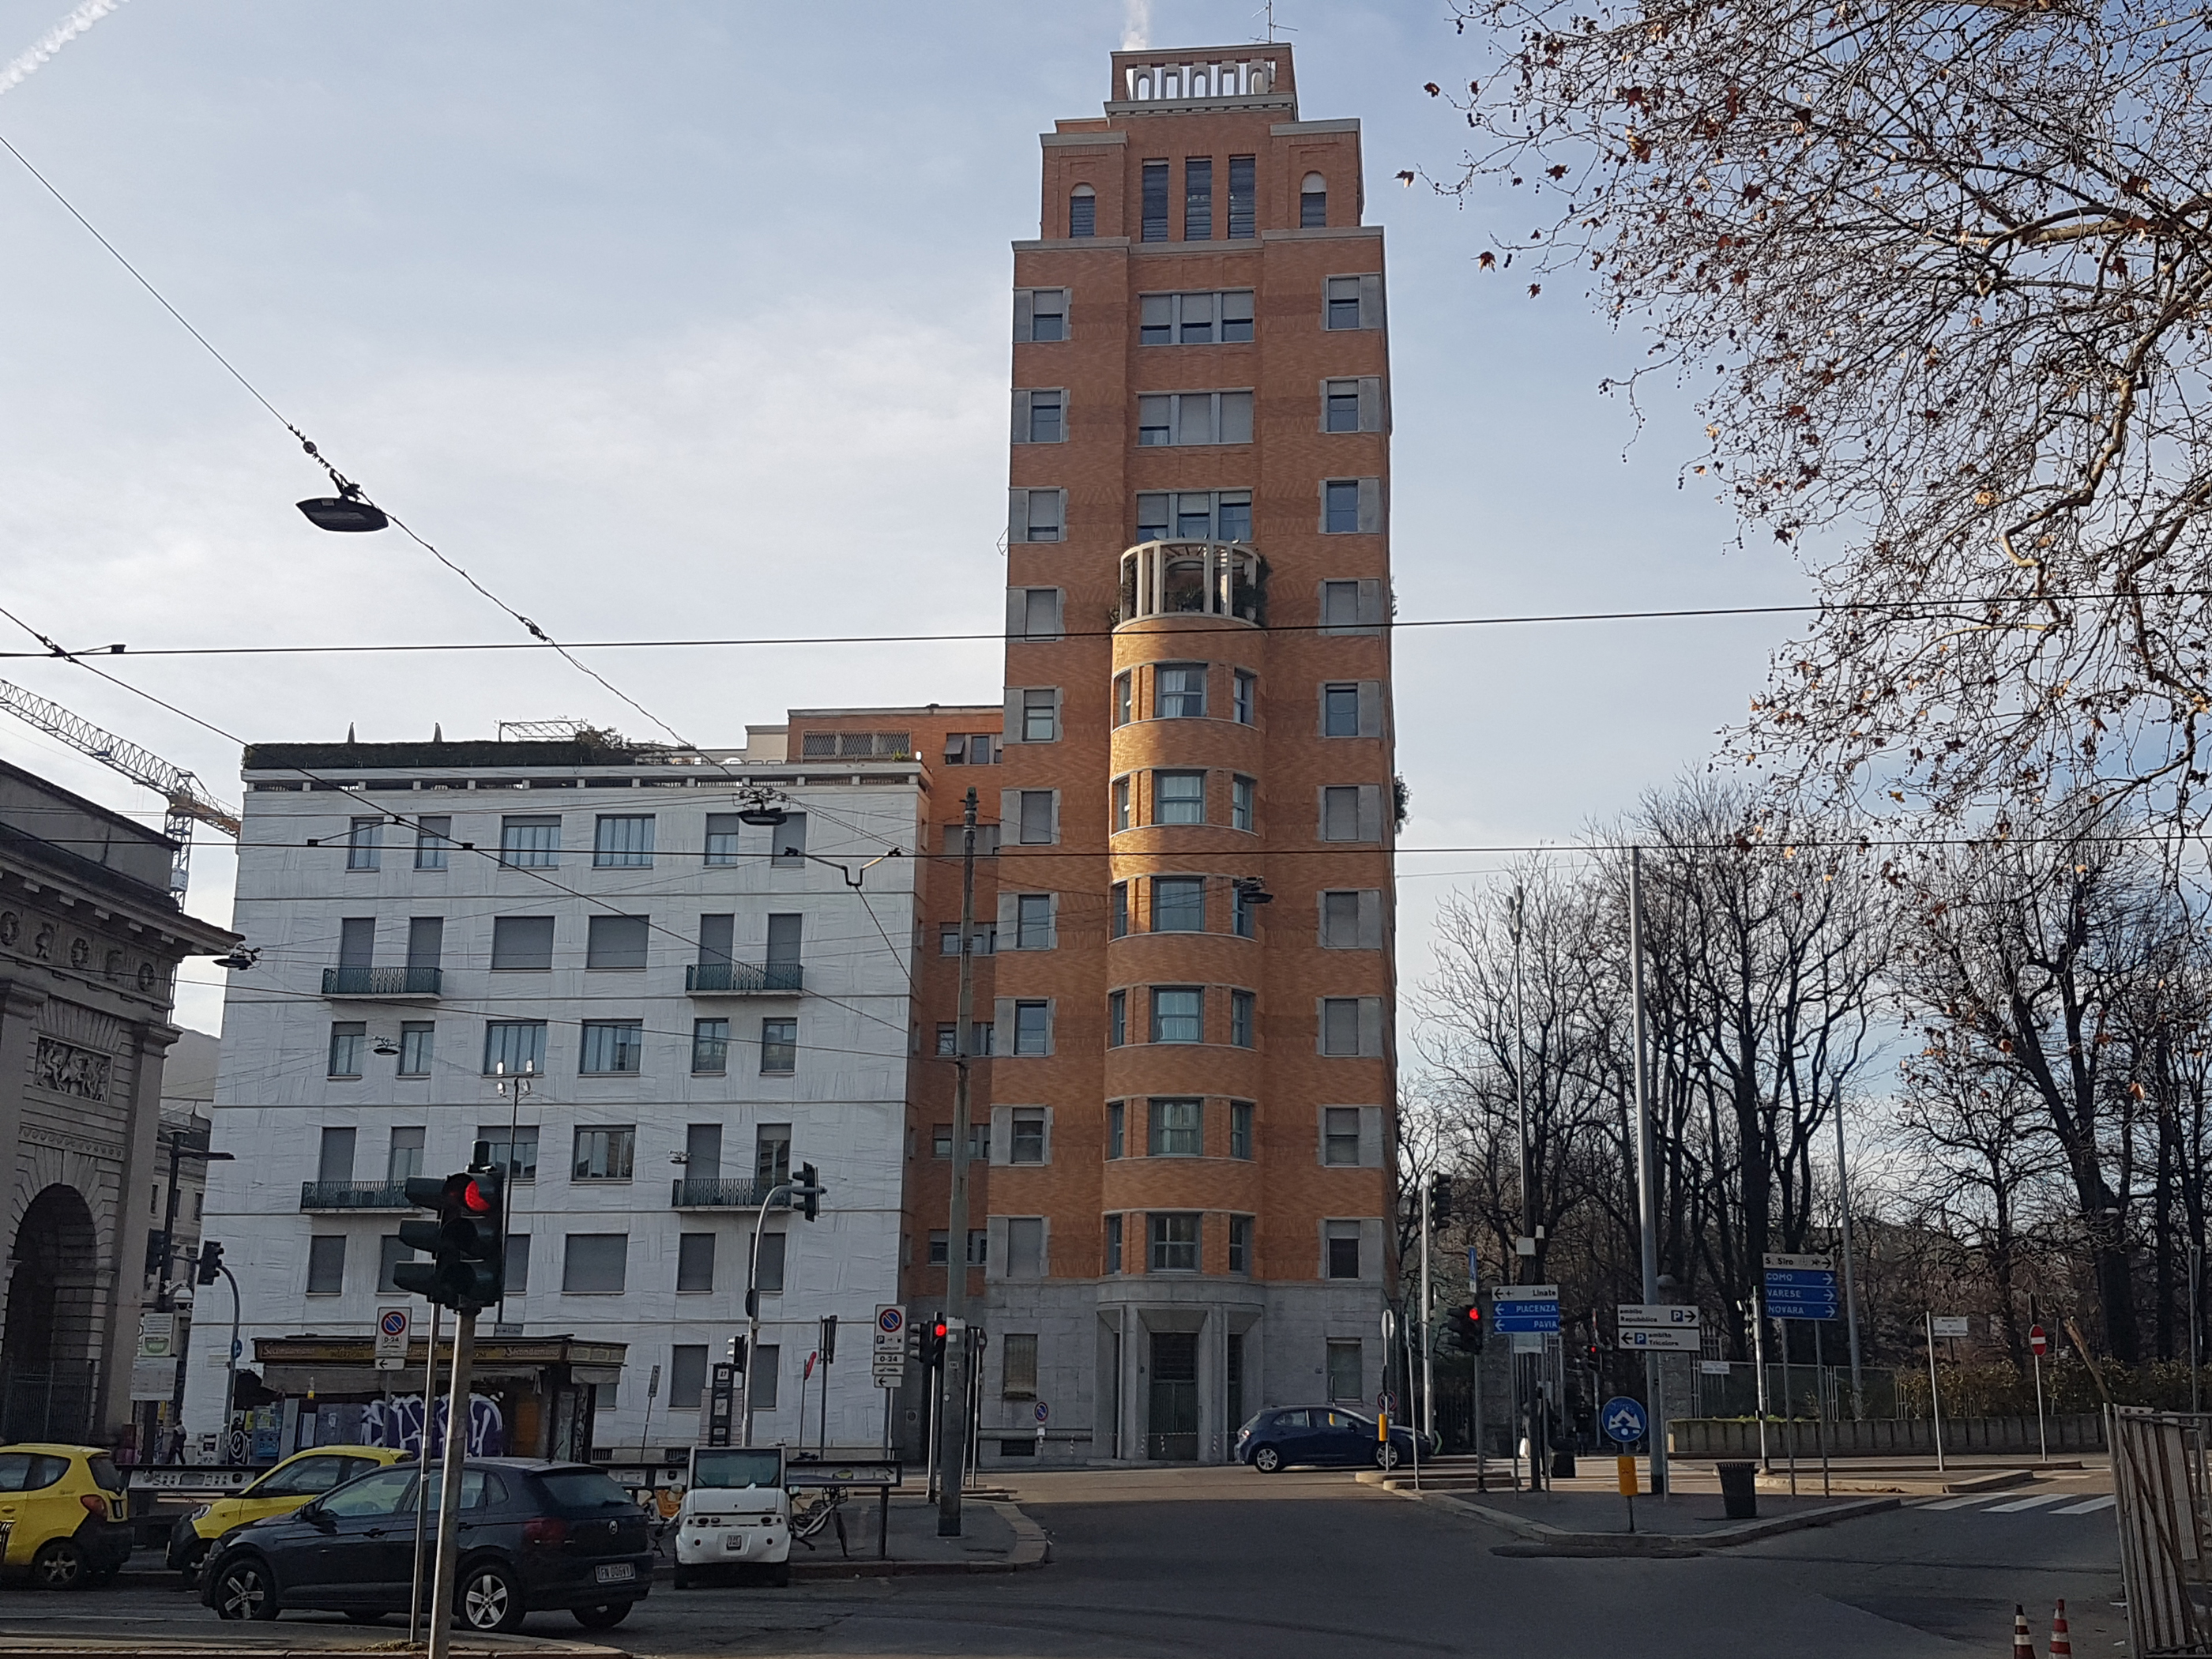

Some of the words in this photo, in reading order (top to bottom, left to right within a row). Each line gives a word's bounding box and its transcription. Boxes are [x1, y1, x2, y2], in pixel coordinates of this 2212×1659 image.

[1778, 1257, 1794, 1266] Siro
[1766, 1272, 1793, 1281] COMO
[1766, 1288, 1801, 1298] VARESE
[1516, 1304, 1556, 1313] PIACENZA
[1768, 1305, 1804, 1314] NOVARA
